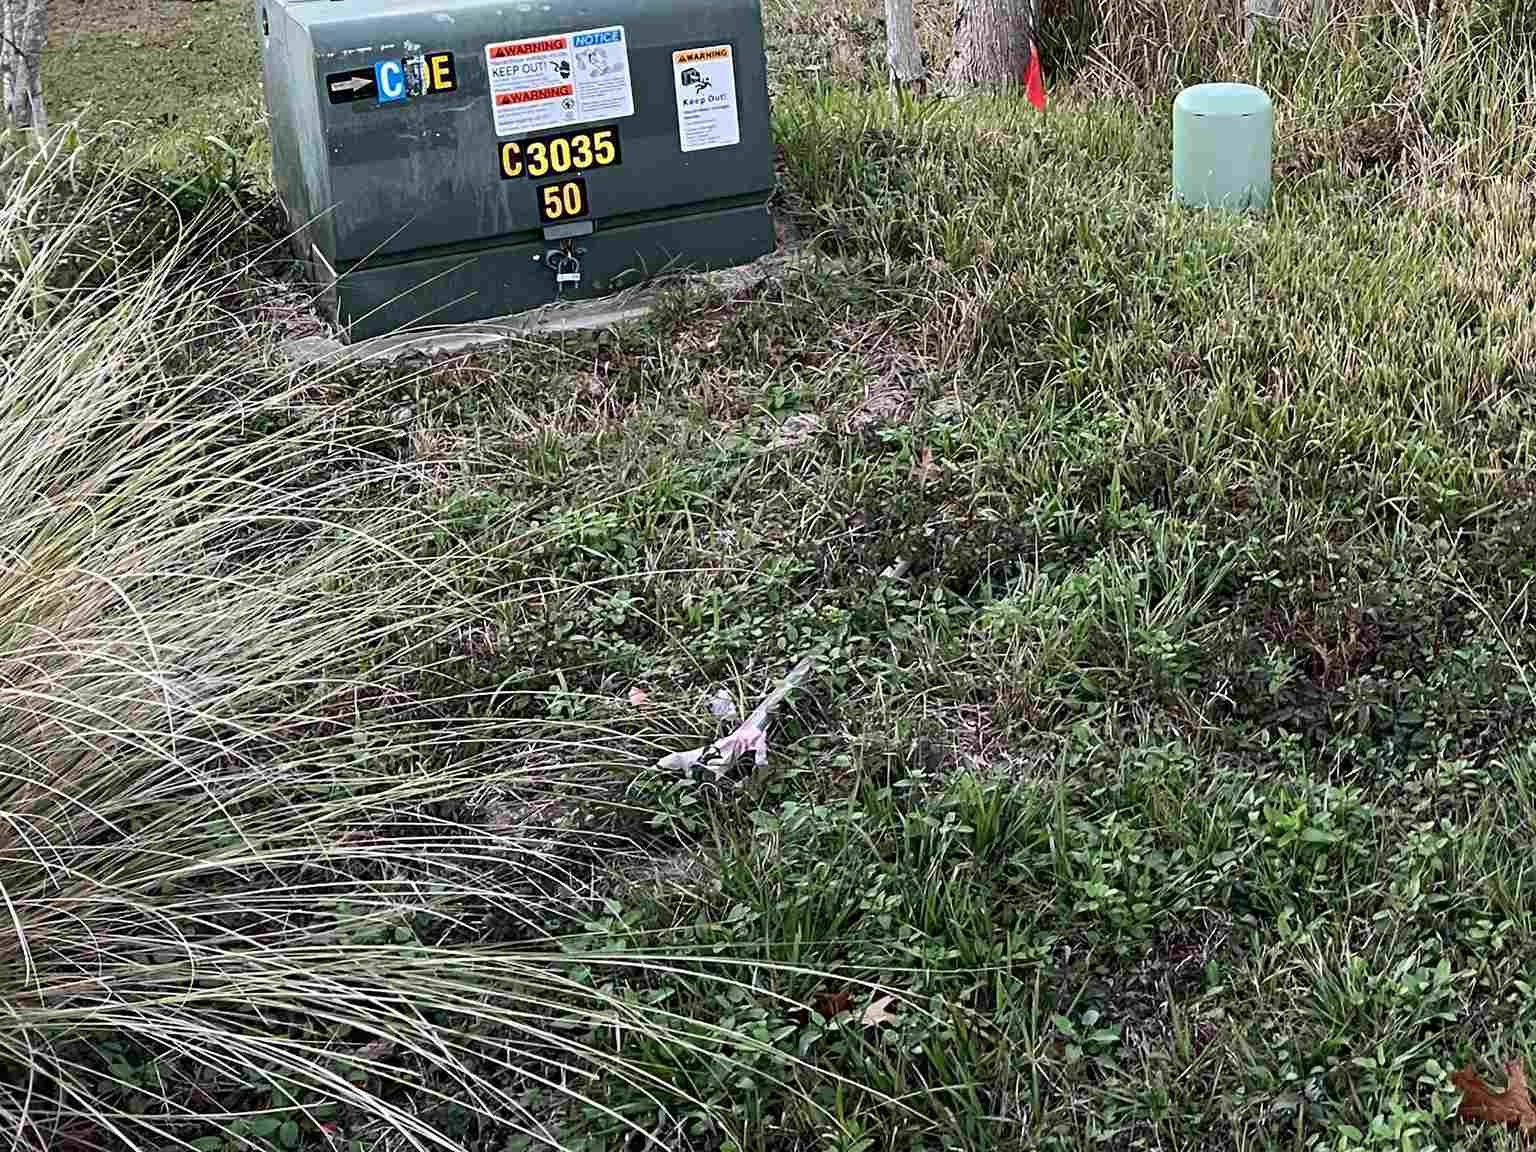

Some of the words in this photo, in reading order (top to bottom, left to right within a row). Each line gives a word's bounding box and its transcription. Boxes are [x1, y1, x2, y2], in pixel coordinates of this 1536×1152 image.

[575, 31, 620, 47] NOTICE
[505, 39, 562, 57] WARNING
[686, 48, 728, 62] WARNING
[492, 65, 520, 79] KEEP
[510, 85, 570, 104] WARNING
[543, 182, 582, 219] 50
